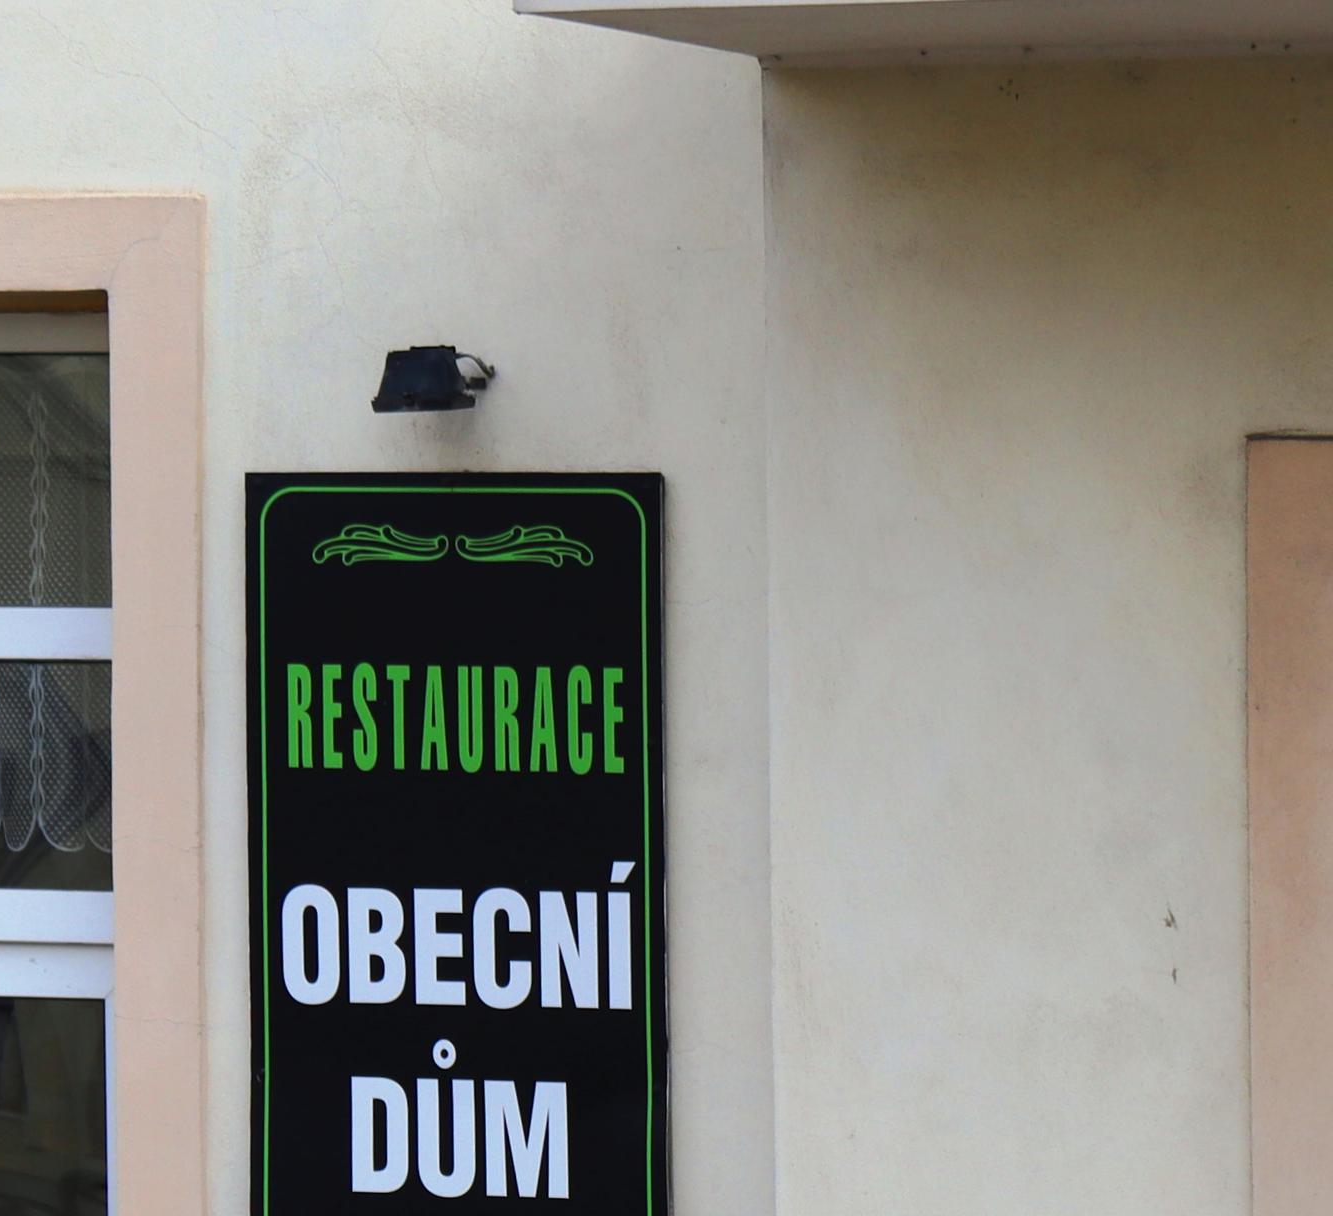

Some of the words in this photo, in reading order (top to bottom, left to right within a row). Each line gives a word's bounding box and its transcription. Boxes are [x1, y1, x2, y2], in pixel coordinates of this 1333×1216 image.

[287, 662, 625, 774] RESTAURACE
[281, 861, 635, 1010] OBECNÍ
[351, 1038, 569, 1200] DŮM
